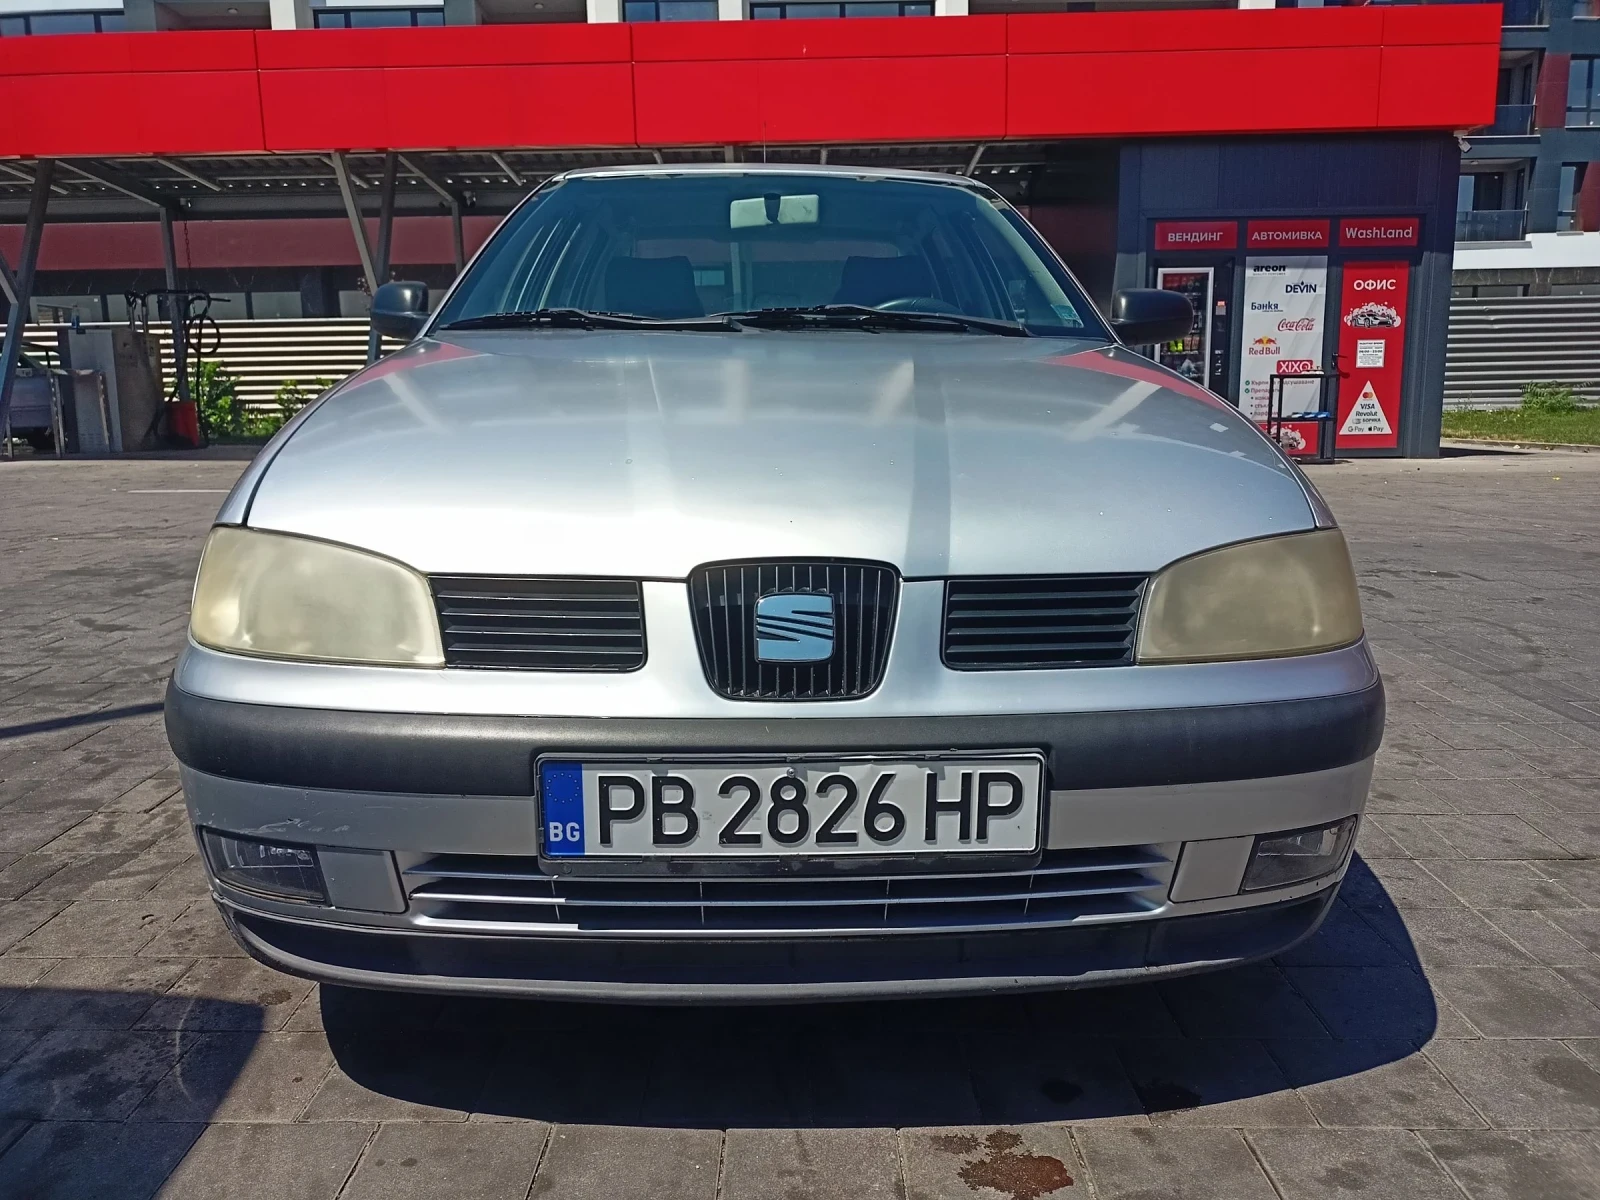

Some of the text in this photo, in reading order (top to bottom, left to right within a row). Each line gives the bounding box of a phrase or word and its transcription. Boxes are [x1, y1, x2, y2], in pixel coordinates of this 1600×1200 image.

[1168, 232, 1223, 242] ВЕНДИНГ
[1252, 231, 1322, 240] АВТОМИВКА
[1345, 226, 1413, 239] WashLand
[1253, 264, 1287, 272] areon
[1285, 283, 1317, 294] DEVIN
[1353, 279, 1397, 291] ОФИС
[1248, 346, 1281, 355] Red Bull
[718, 771, 905, 845] 2826
[549, 821, 581, 842] BG
